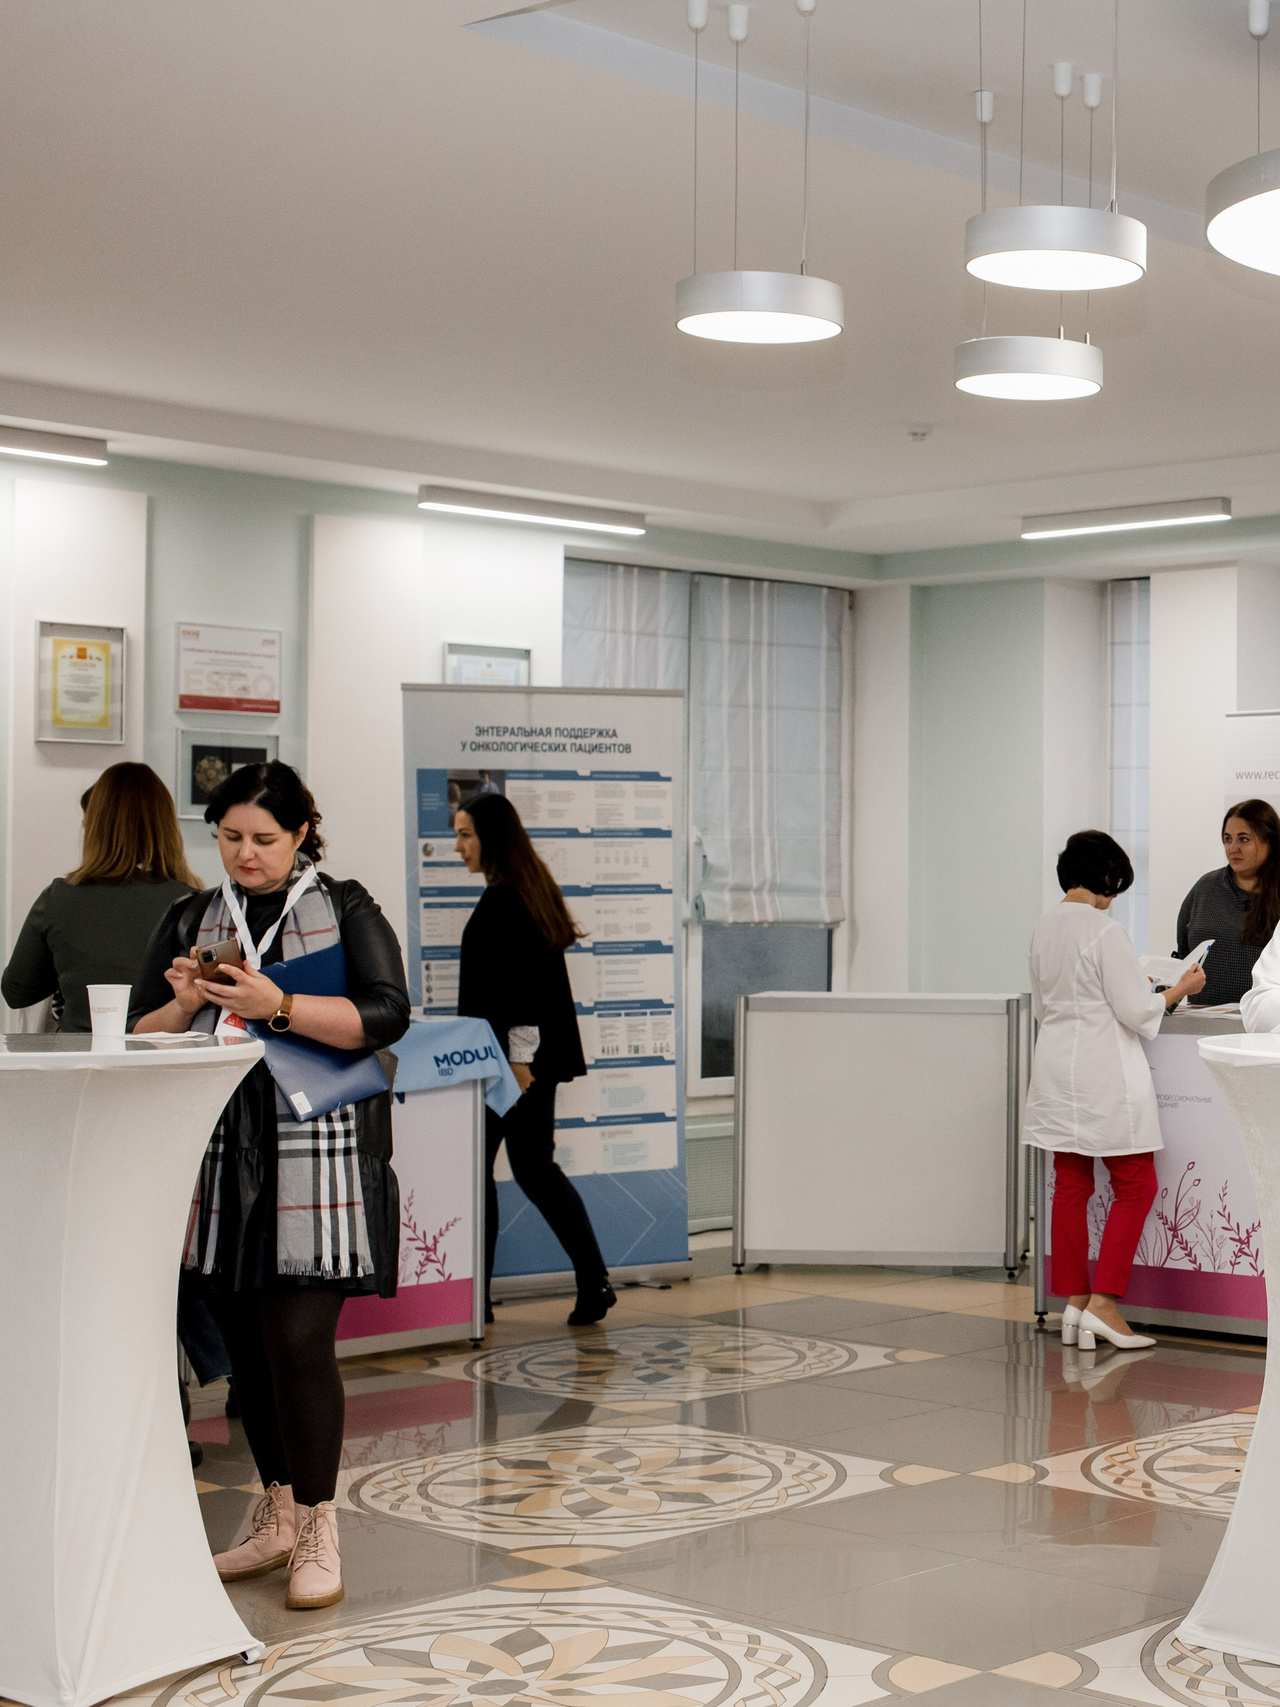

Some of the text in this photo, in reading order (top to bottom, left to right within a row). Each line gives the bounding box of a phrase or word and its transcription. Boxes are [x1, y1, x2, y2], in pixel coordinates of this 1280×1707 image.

[474, 725, 618, 740] ЭНТЕРАЛЬНАЯ ПОДДЕРЖКА
[460, 740, 632, 755] У ОНКОЛОГИЧЕСКИХ ПАЦИЕНТОВ
[438, 1067, 454, 1077] IBD
